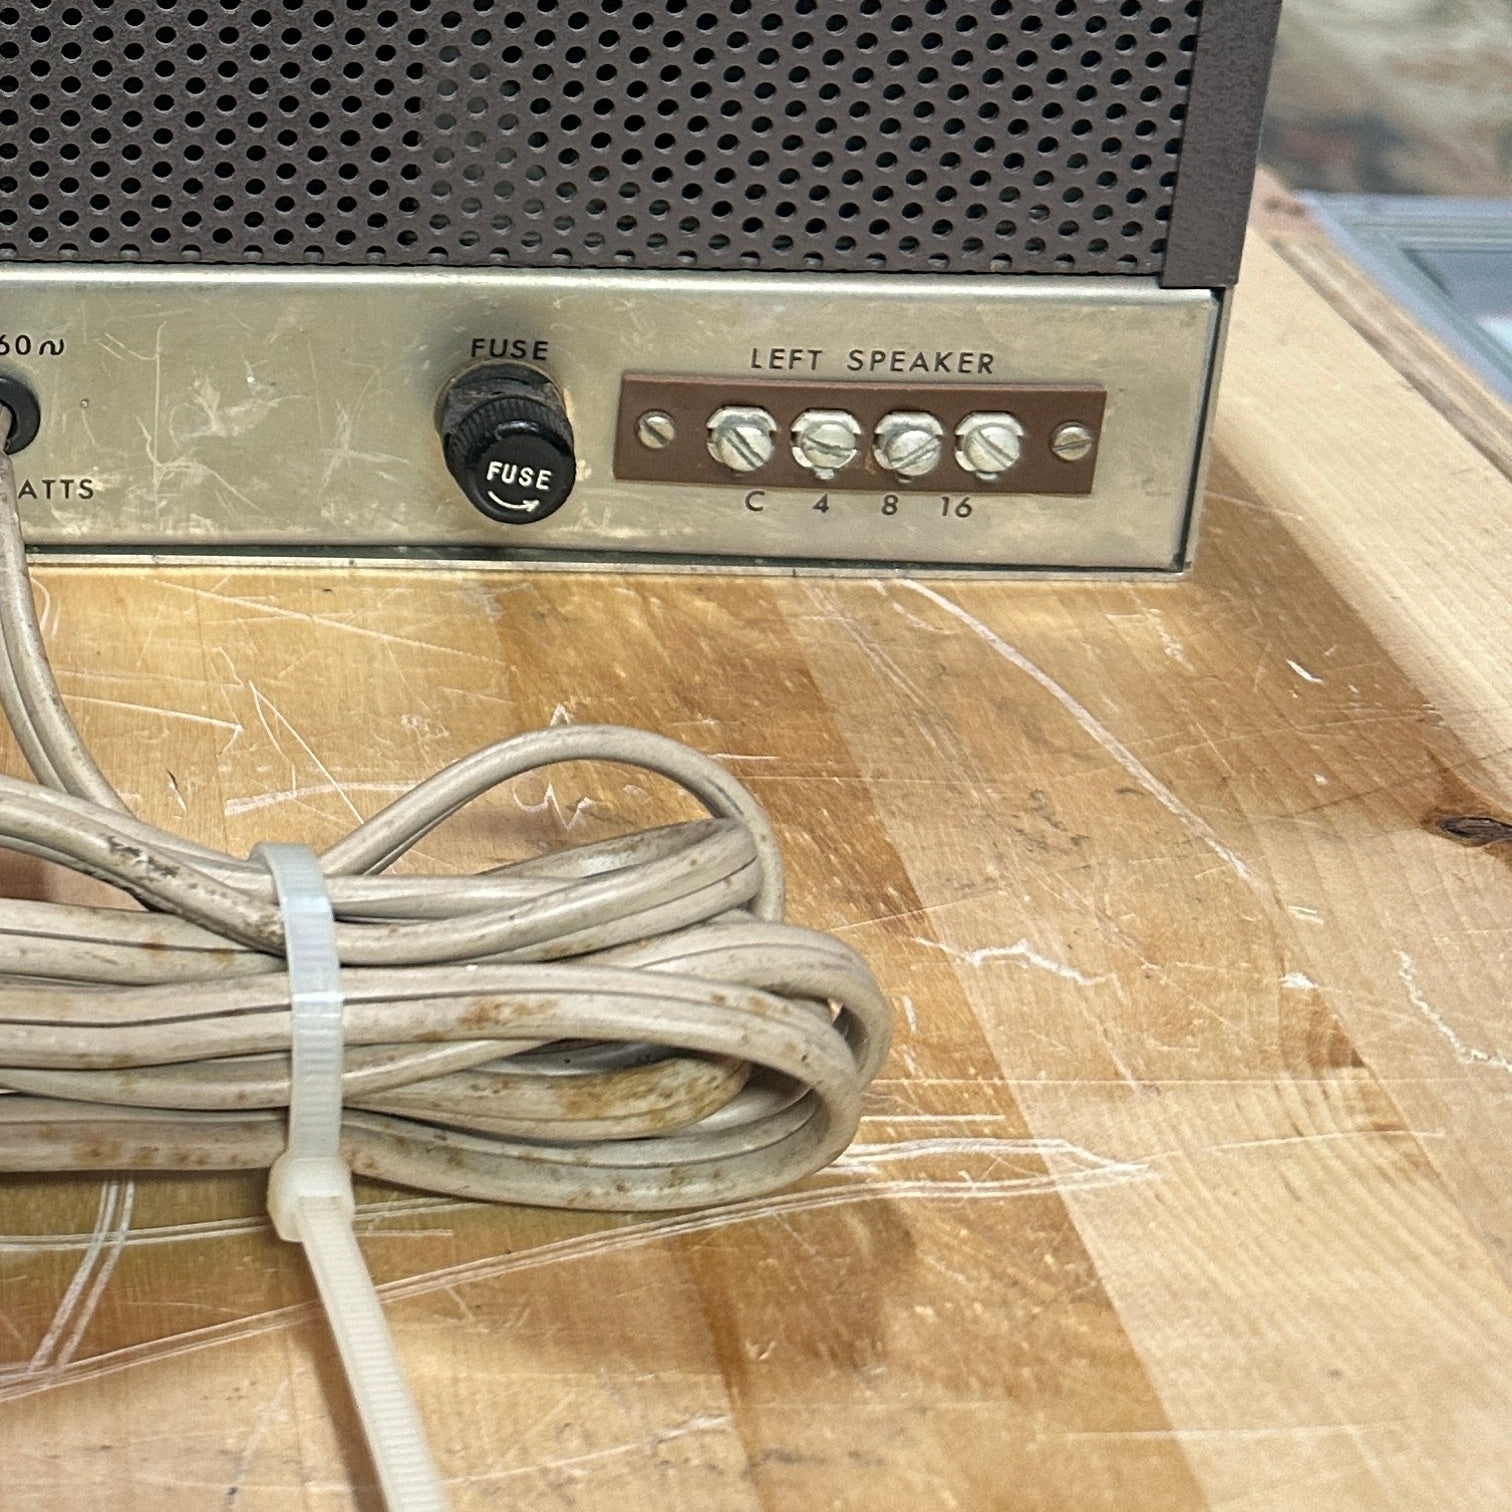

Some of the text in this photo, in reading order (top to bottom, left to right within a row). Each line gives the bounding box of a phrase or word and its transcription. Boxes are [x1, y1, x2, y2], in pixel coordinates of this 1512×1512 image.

[471, 338, 548, 361] FUSE
[750, 348, 994, 374] LEFT SPEAKER
[486, 460, 553, 491] FUSE
[18, 479, 94, 500] ATTS
[744, 491, 973, 518] C 4 8 16
